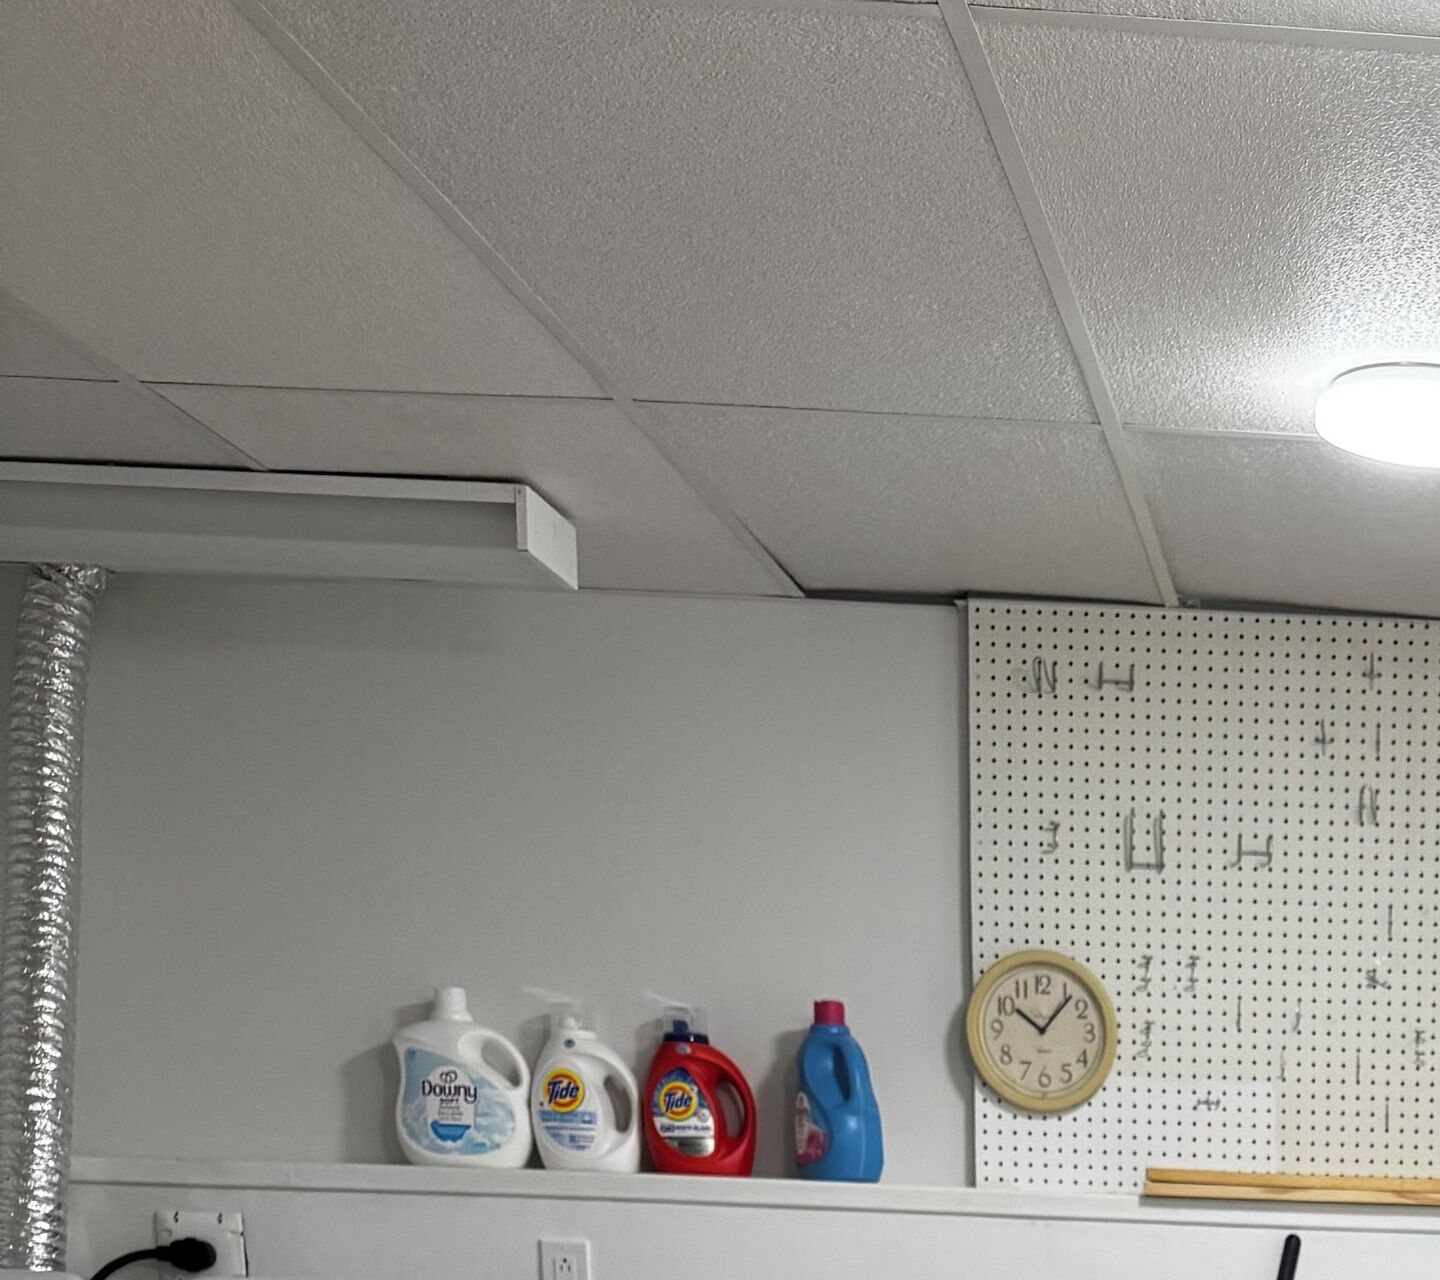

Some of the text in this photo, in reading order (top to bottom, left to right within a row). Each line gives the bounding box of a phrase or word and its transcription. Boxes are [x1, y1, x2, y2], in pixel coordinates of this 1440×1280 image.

[1016, 980, 1028, 999] 11
[1035, 975, 1051, 995] 12
[997, 996, 1015, 1016] 10
[1075, 999, 1088, 1019] 2
[991, 1018, 1004, 1041] 9
[1083, 1023, 1096, 1043] 3
[1000, 1044, 1013, 1065] 8
[1076, 1049, 1088, 1068] 4
[1020, 1061, 1032, 1081] 7
[1038, 1066, 1052, 1088] 6
[1060, 1063, 1073, 1084] 5
[422, 1080, 477, 1104] Downy
[548, 1080, 579, 1104] Tide
[664, 1091, 693, 1112] Tide
